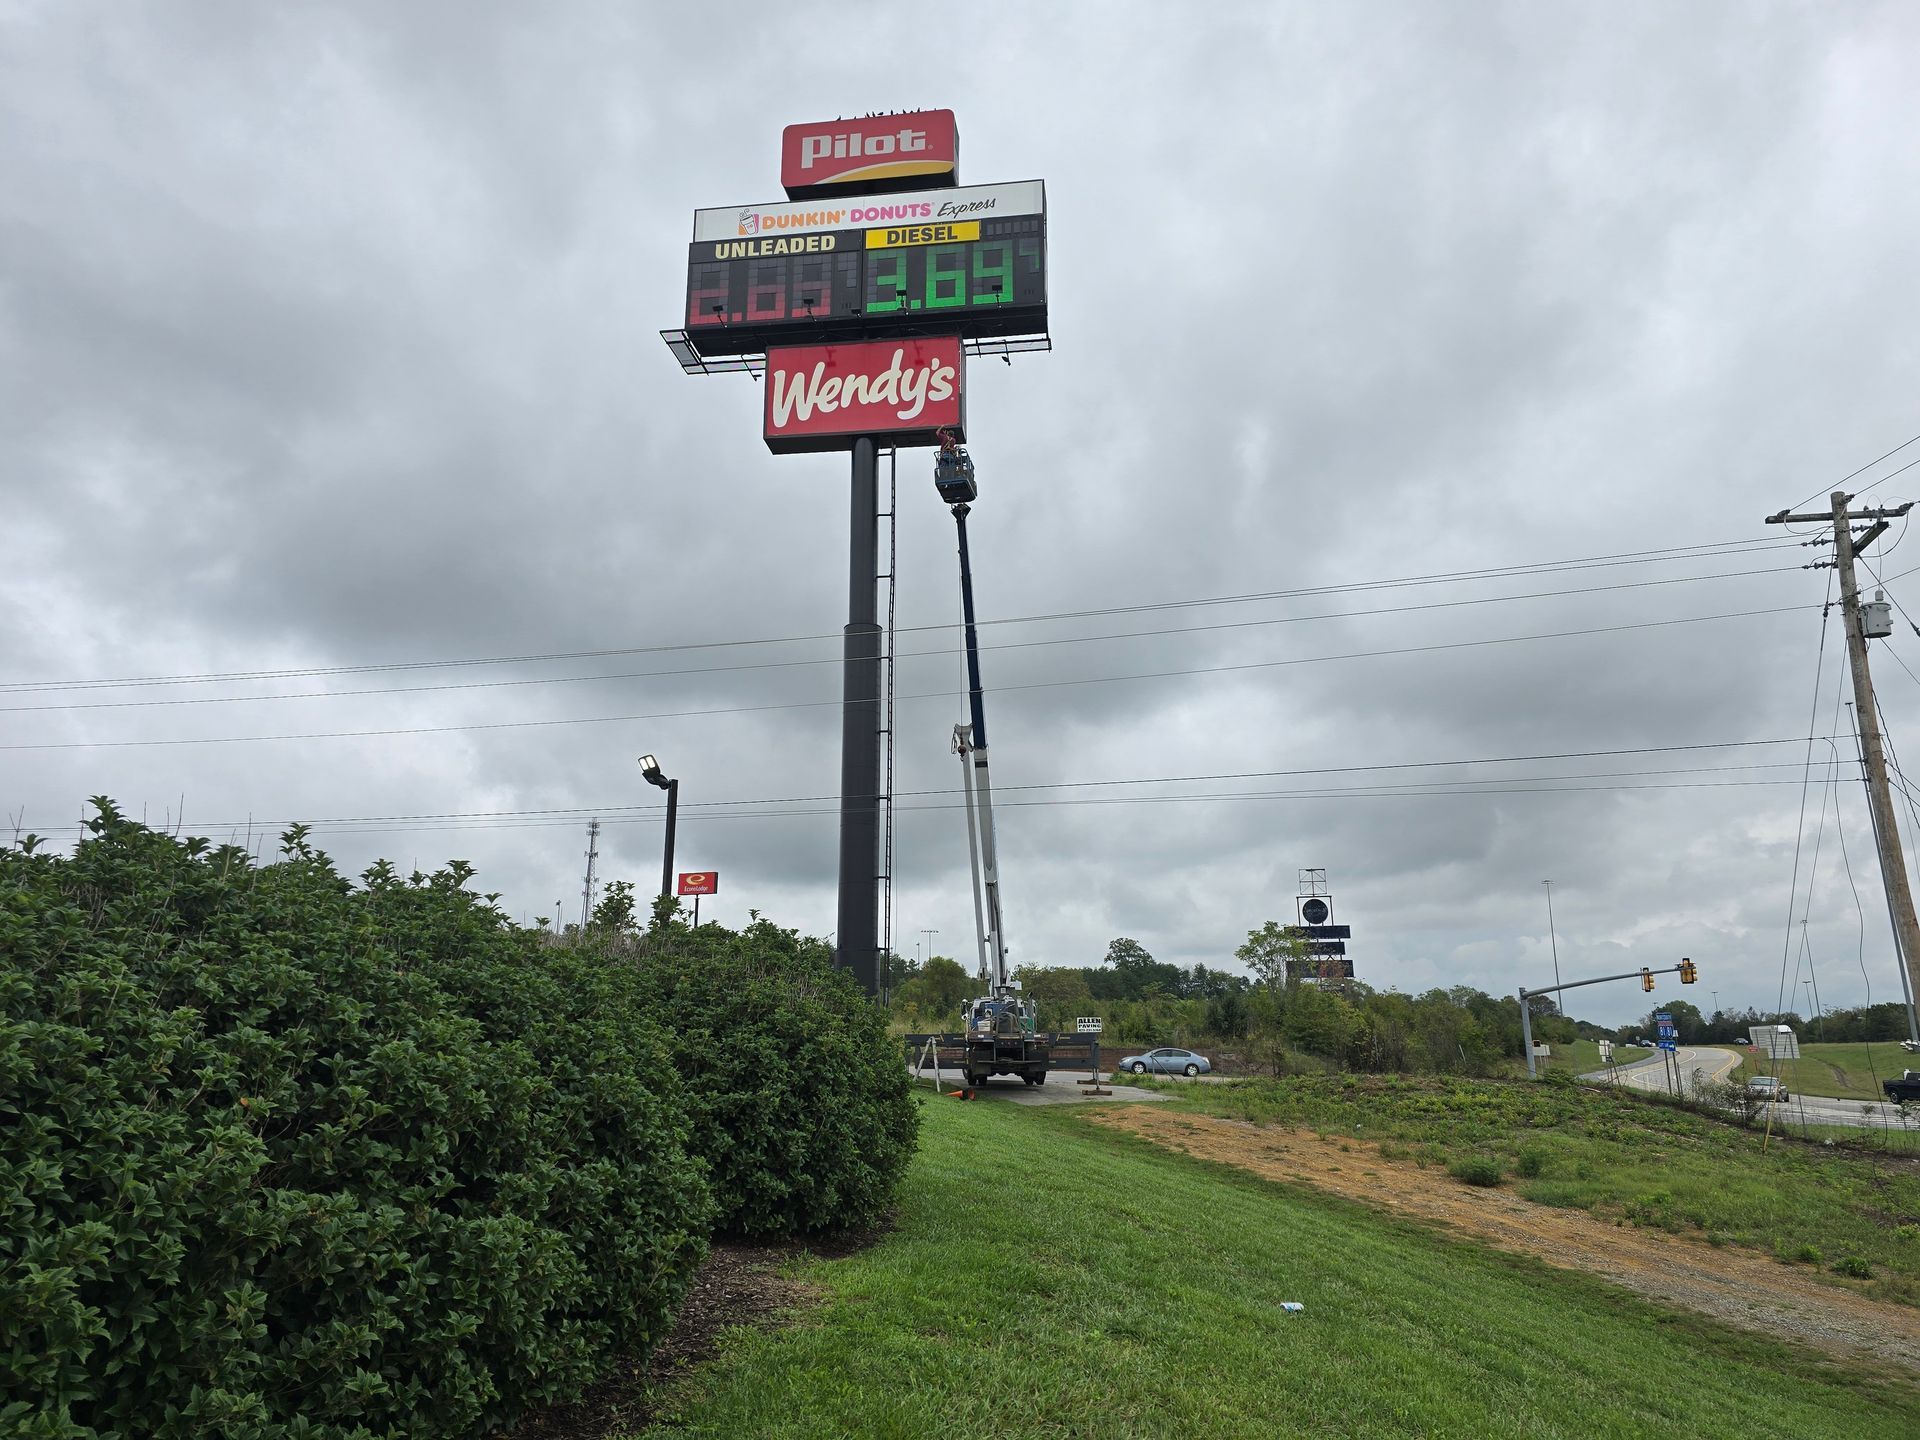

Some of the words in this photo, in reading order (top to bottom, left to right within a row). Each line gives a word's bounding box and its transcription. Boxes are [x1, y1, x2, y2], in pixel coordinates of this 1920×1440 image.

[801, 129, 926, 169] Pilot
[761, 208, 847, 230] DUNKIN'
[850, 202, 932, 223] DONUTS
[937, 198, 996, 219] Express
[715, 235, 836, 260] UNLEADED
[886, 226, 958, 245] DIESEL
[772, 349, 956, 428] Wendy's
